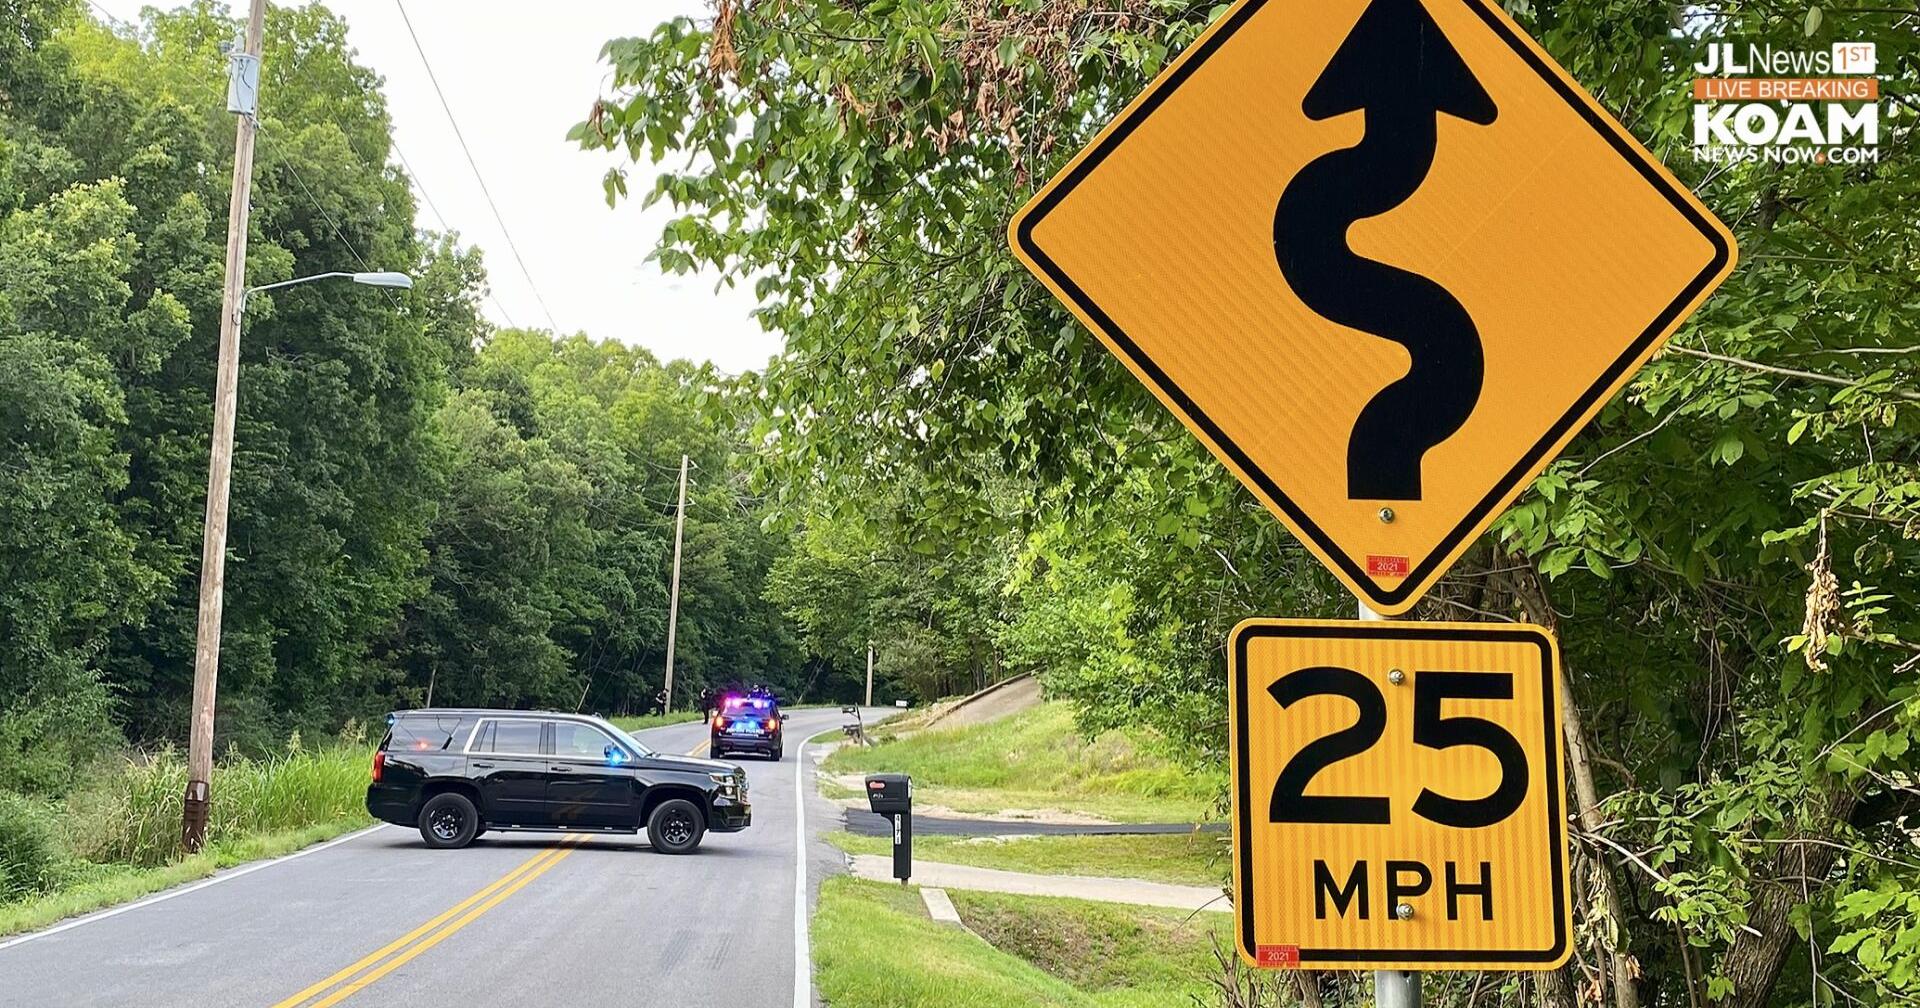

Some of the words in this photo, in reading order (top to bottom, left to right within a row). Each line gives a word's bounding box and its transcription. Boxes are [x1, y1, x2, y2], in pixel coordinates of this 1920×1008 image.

[1377, 562, 1398, 571] 2021
[1266, 666, 1529, 828] 25
[1313, 859, 1493, 921] MPH
[1268, 951, 1289, 961] 2021
